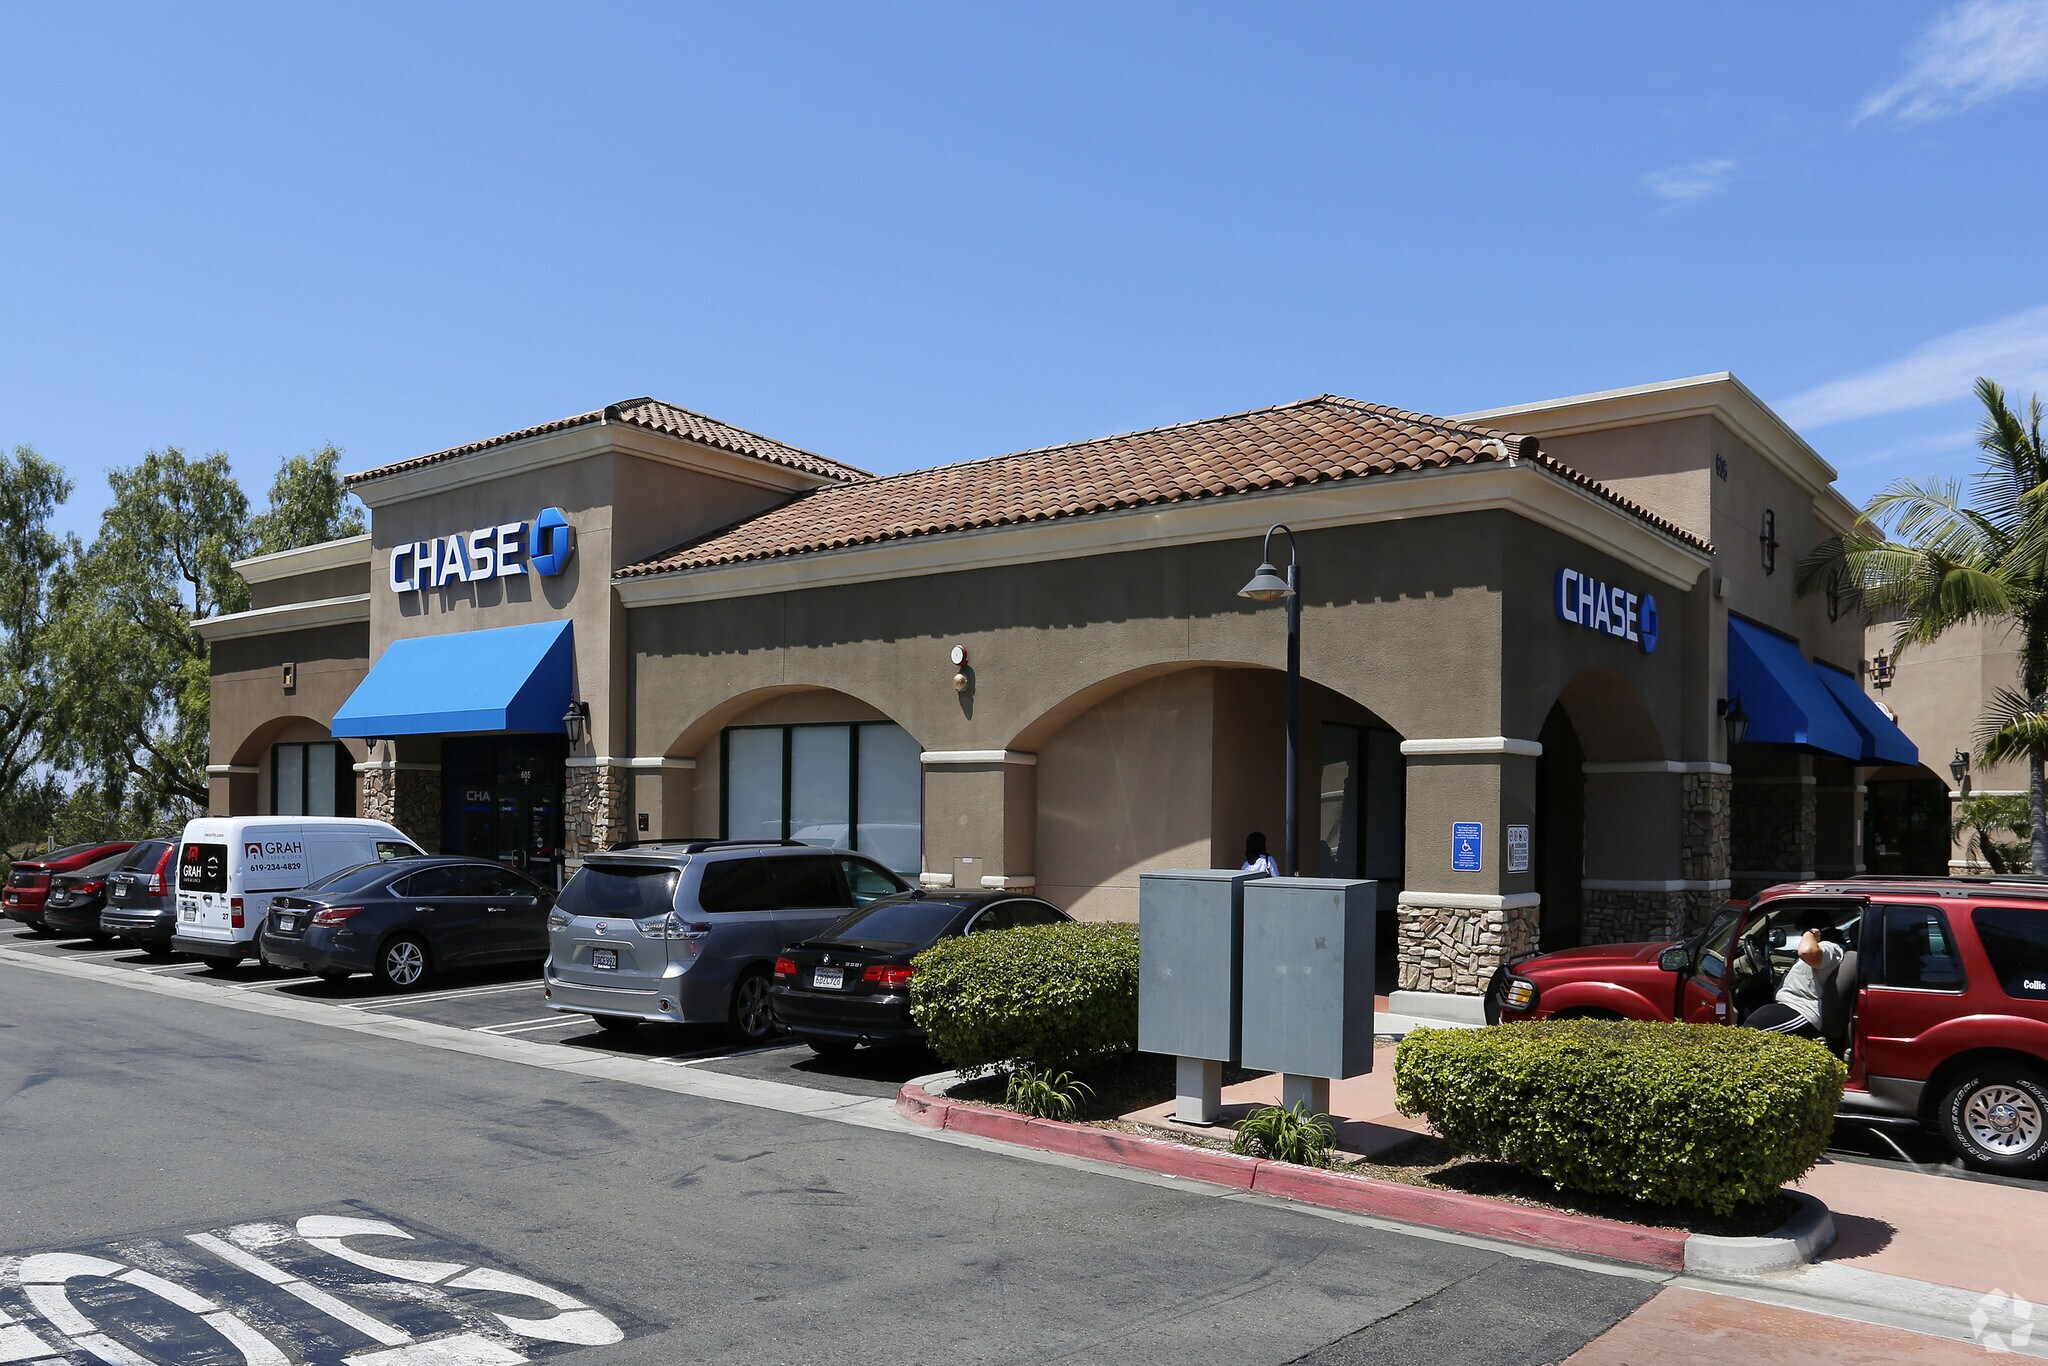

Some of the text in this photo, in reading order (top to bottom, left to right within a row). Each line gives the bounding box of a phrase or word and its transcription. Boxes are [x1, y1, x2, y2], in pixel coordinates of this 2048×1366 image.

[1716, 454, 1728, 482] 605
[389, 521, 526, 593] CHASE
[1560, 567, 1639, 643] CHASE
[520, 771, 531, 779] 605
[265, 842, 302, 854] GRAH
[183, 865, 202, 878] GRAH
[250, 862, 301, 872] 619-234-4829
[2023, 979, 2046, 990] Collie
[1140, 1136, 1168, 1146] NO
[1173, 1143, 1254, 1162] PARKING
[1270, 1160, 1314, 1172] FIRE
